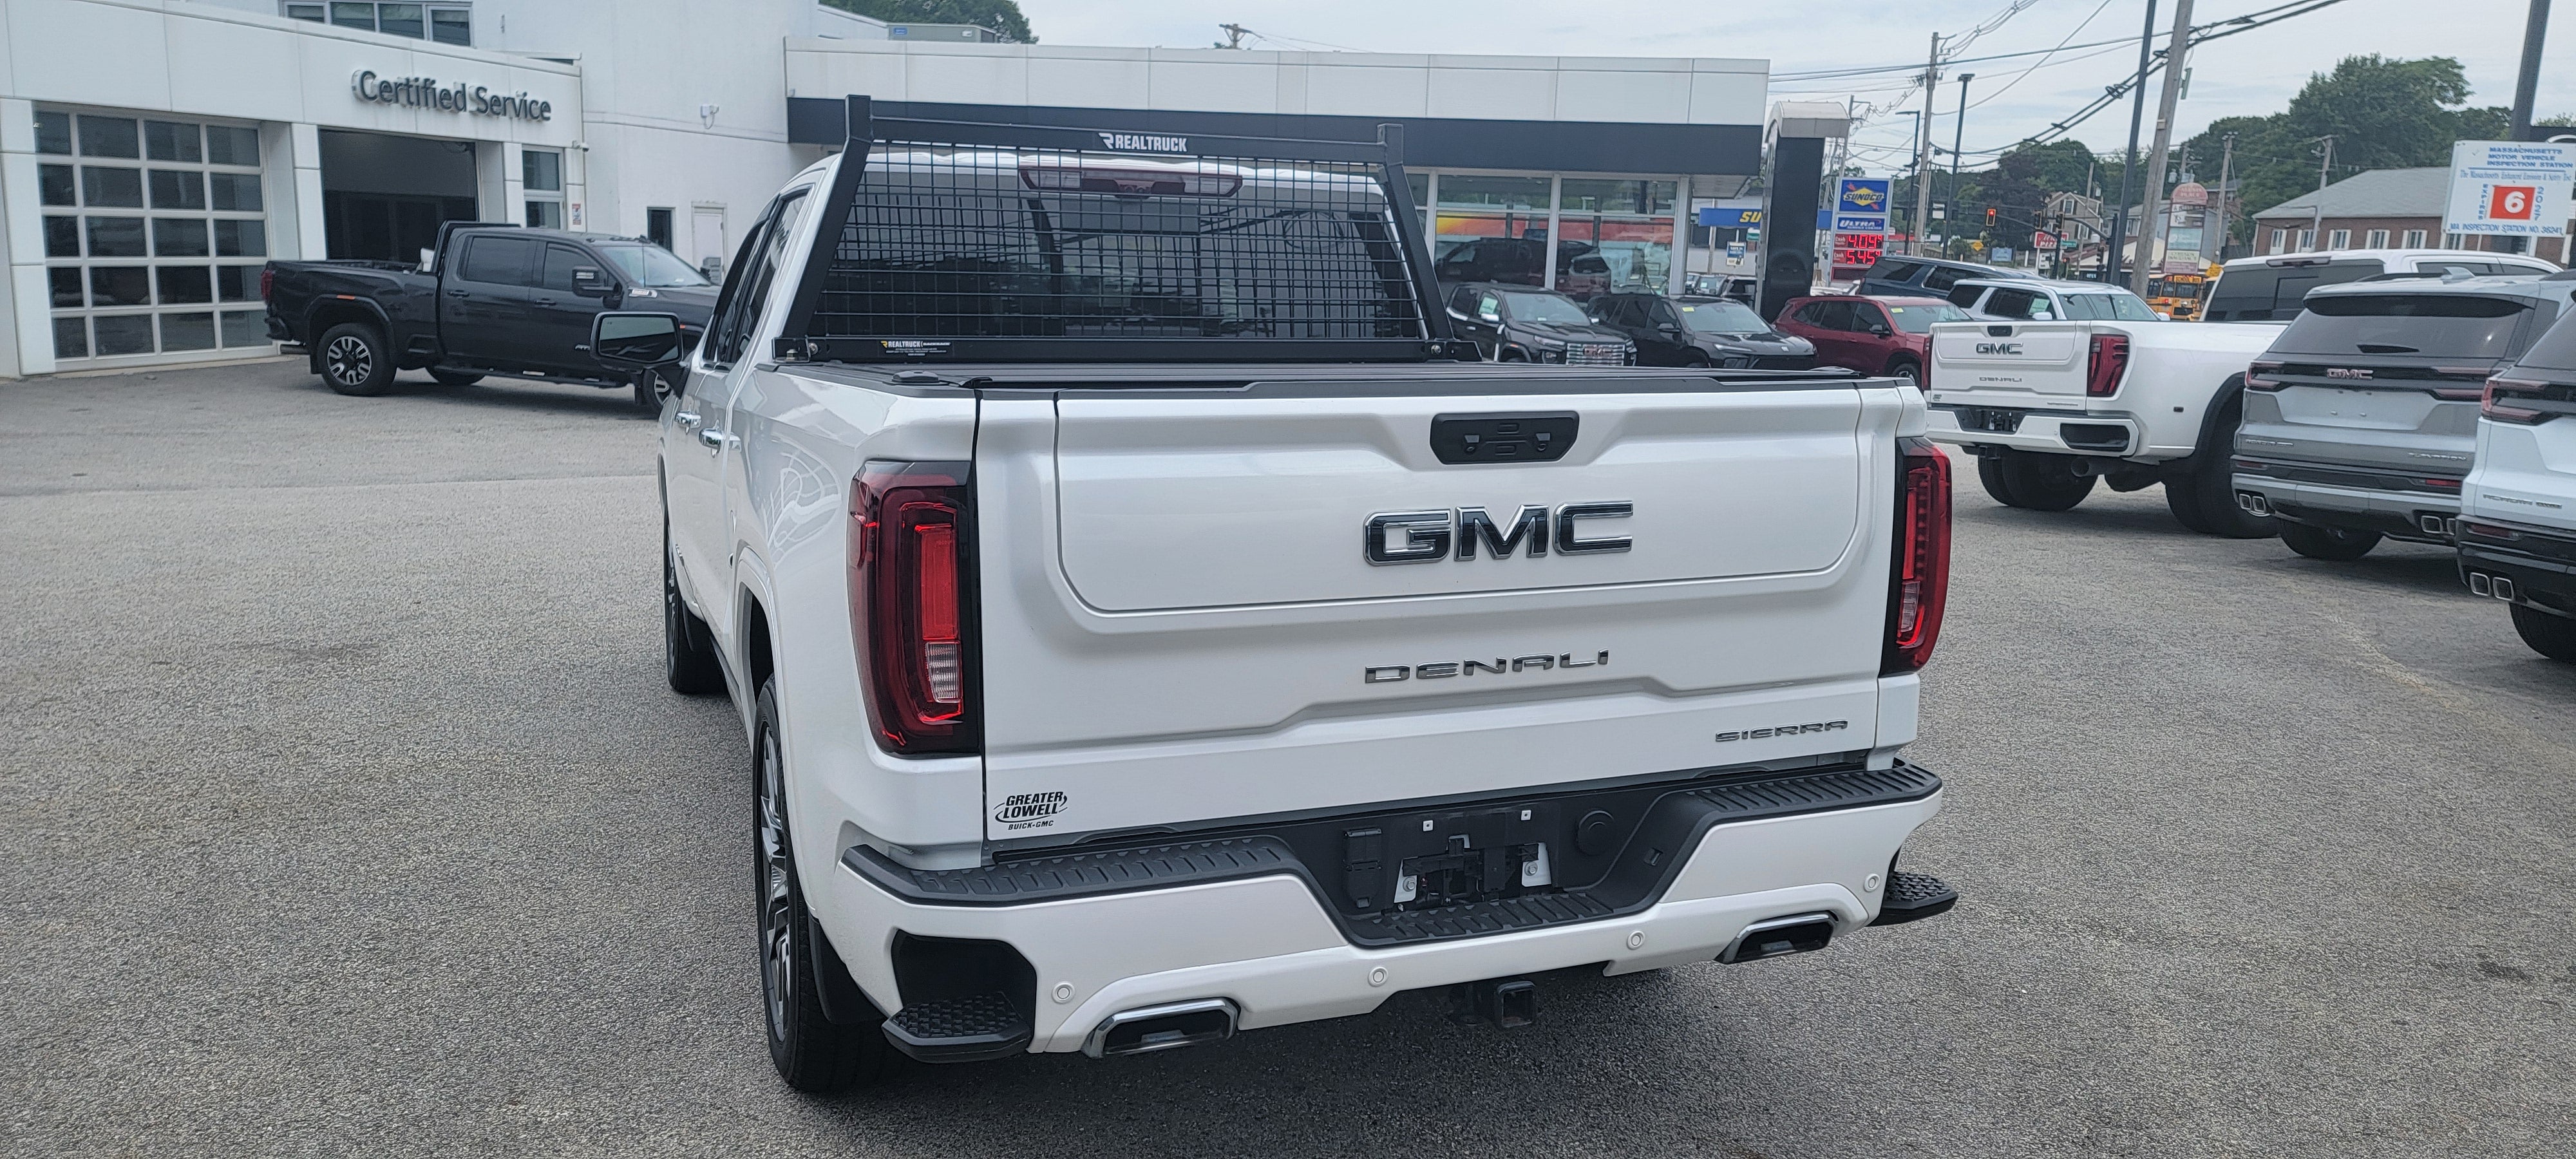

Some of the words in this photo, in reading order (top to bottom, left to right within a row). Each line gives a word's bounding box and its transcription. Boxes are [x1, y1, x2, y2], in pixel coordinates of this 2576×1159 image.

[357, 70, 467, 112] Certified
[474, 86, 552, 121] Service
[1115, 135, 1188, 152] REALTRUCK
[1844, 193, 1883, 201] SUNOCO
[2505, 191, 2526, 214] 6
[1976, 343, 2023, 355] GMC
[2327, 368, 2374, 381] GMC
[1363, 500, 1634, 567] GMC
[1365, 648, 1609, 684] DENALI
[1715, 719, 1849, 742] SIERRA
[1005, 791, 1064, 806] GREATER
[1003, 802, 1058, 819] LOWELL
[1008, 820, 1054, 831] BUICK-GMC
